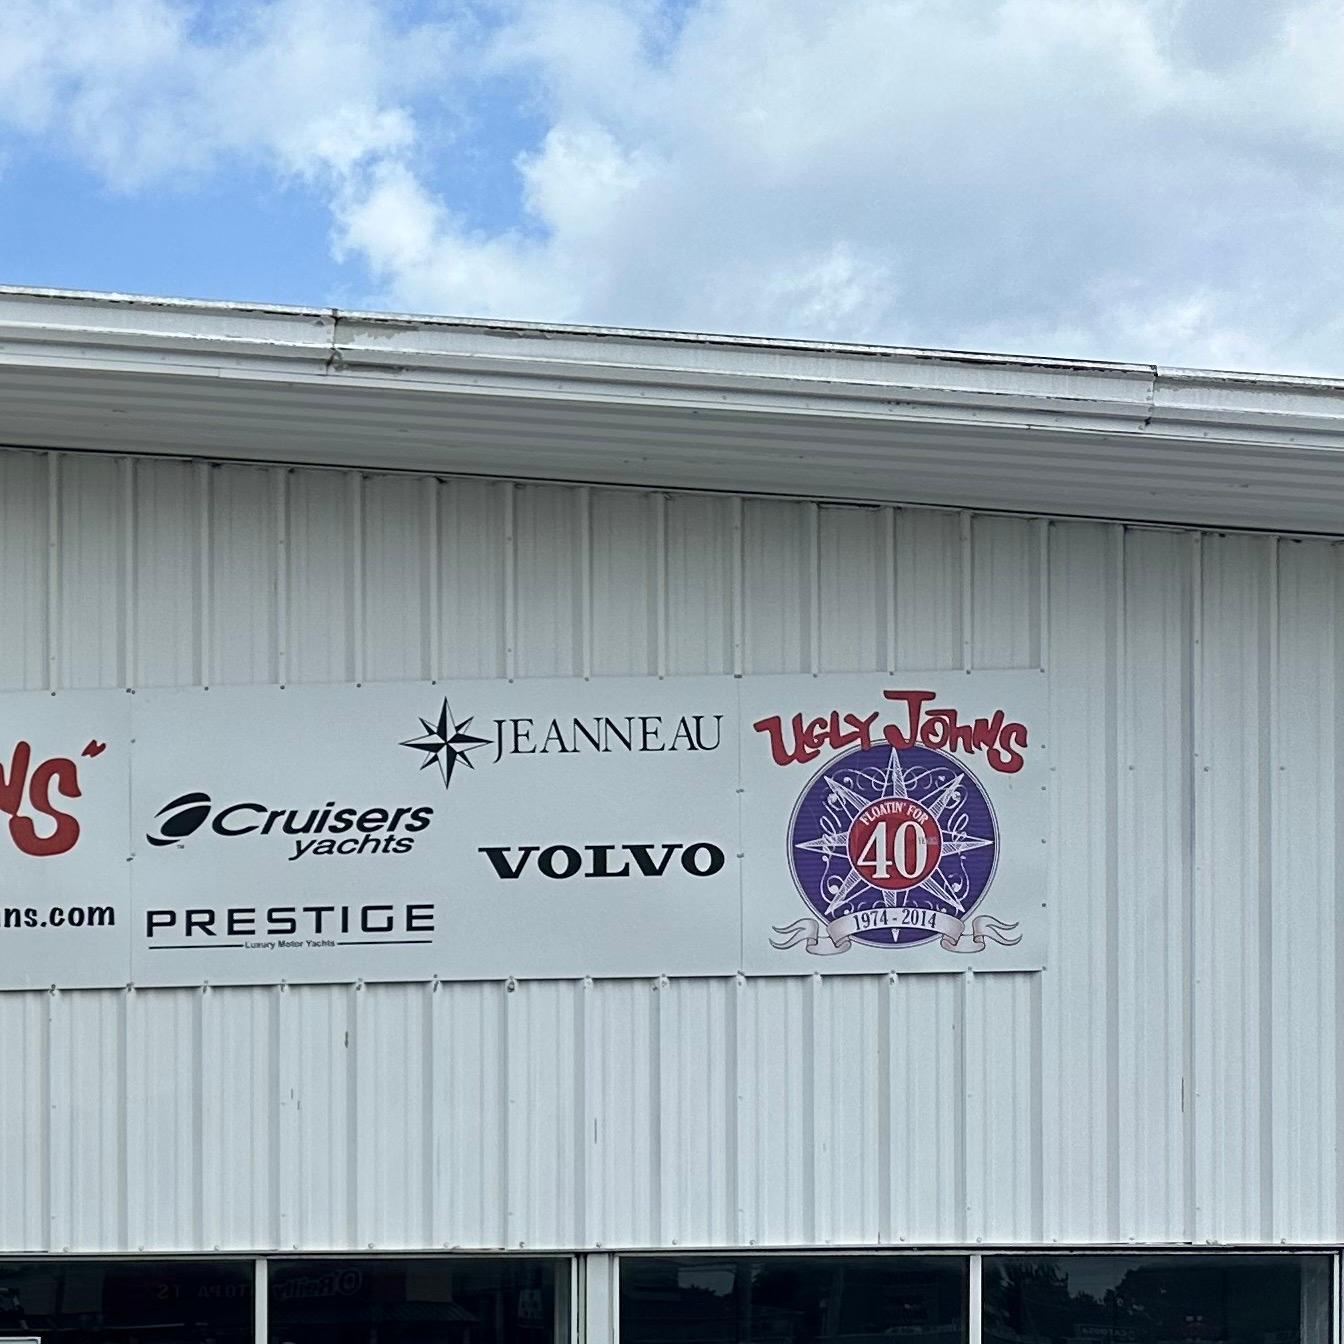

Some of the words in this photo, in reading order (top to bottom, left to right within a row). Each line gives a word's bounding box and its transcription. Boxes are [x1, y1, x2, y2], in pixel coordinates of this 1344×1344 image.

[493, 714, 724, 763] JEANNEAU
[212, 801, 434, 836] Cruisers
[906, 805, 929, 824] FOR
[288, 832, 414, 861] yachts
[478, 842, 725, 880] VOLVO
[857, 820, 928, 880] 40
[146, 904, 435, 937] PRESTIGE
[853, 910, 888, 929] 1974
[902, 908, 937, 928] 2014
